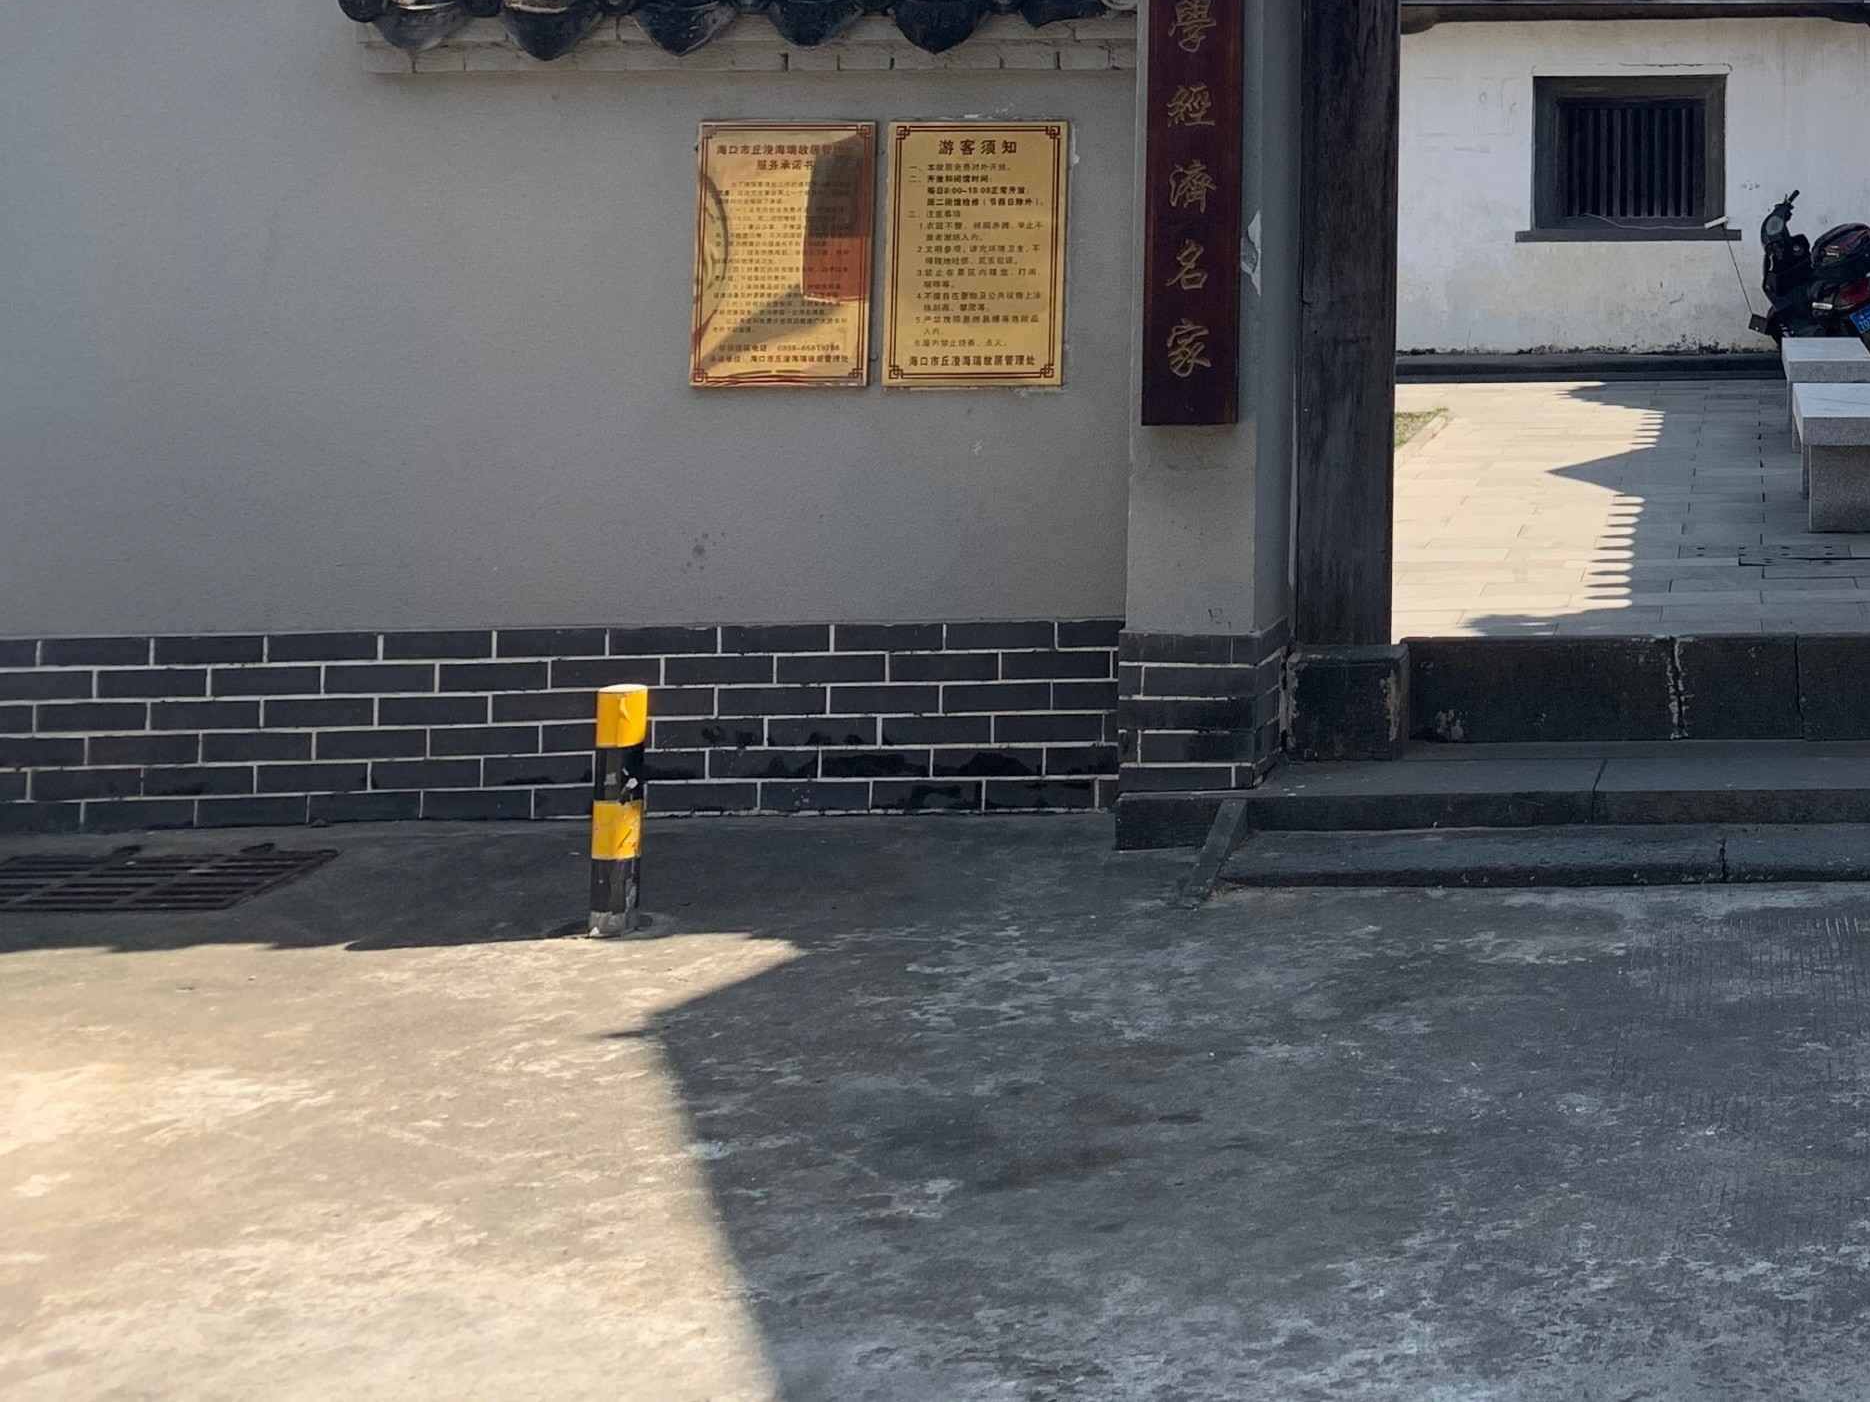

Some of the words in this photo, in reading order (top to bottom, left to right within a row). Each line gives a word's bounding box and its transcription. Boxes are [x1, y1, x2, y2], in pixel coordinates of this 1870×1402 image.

[938, 139, 1018, 156] 游客须知
[908, 354, 1036, 367] 海口市丘浚海瑞故居管理处
